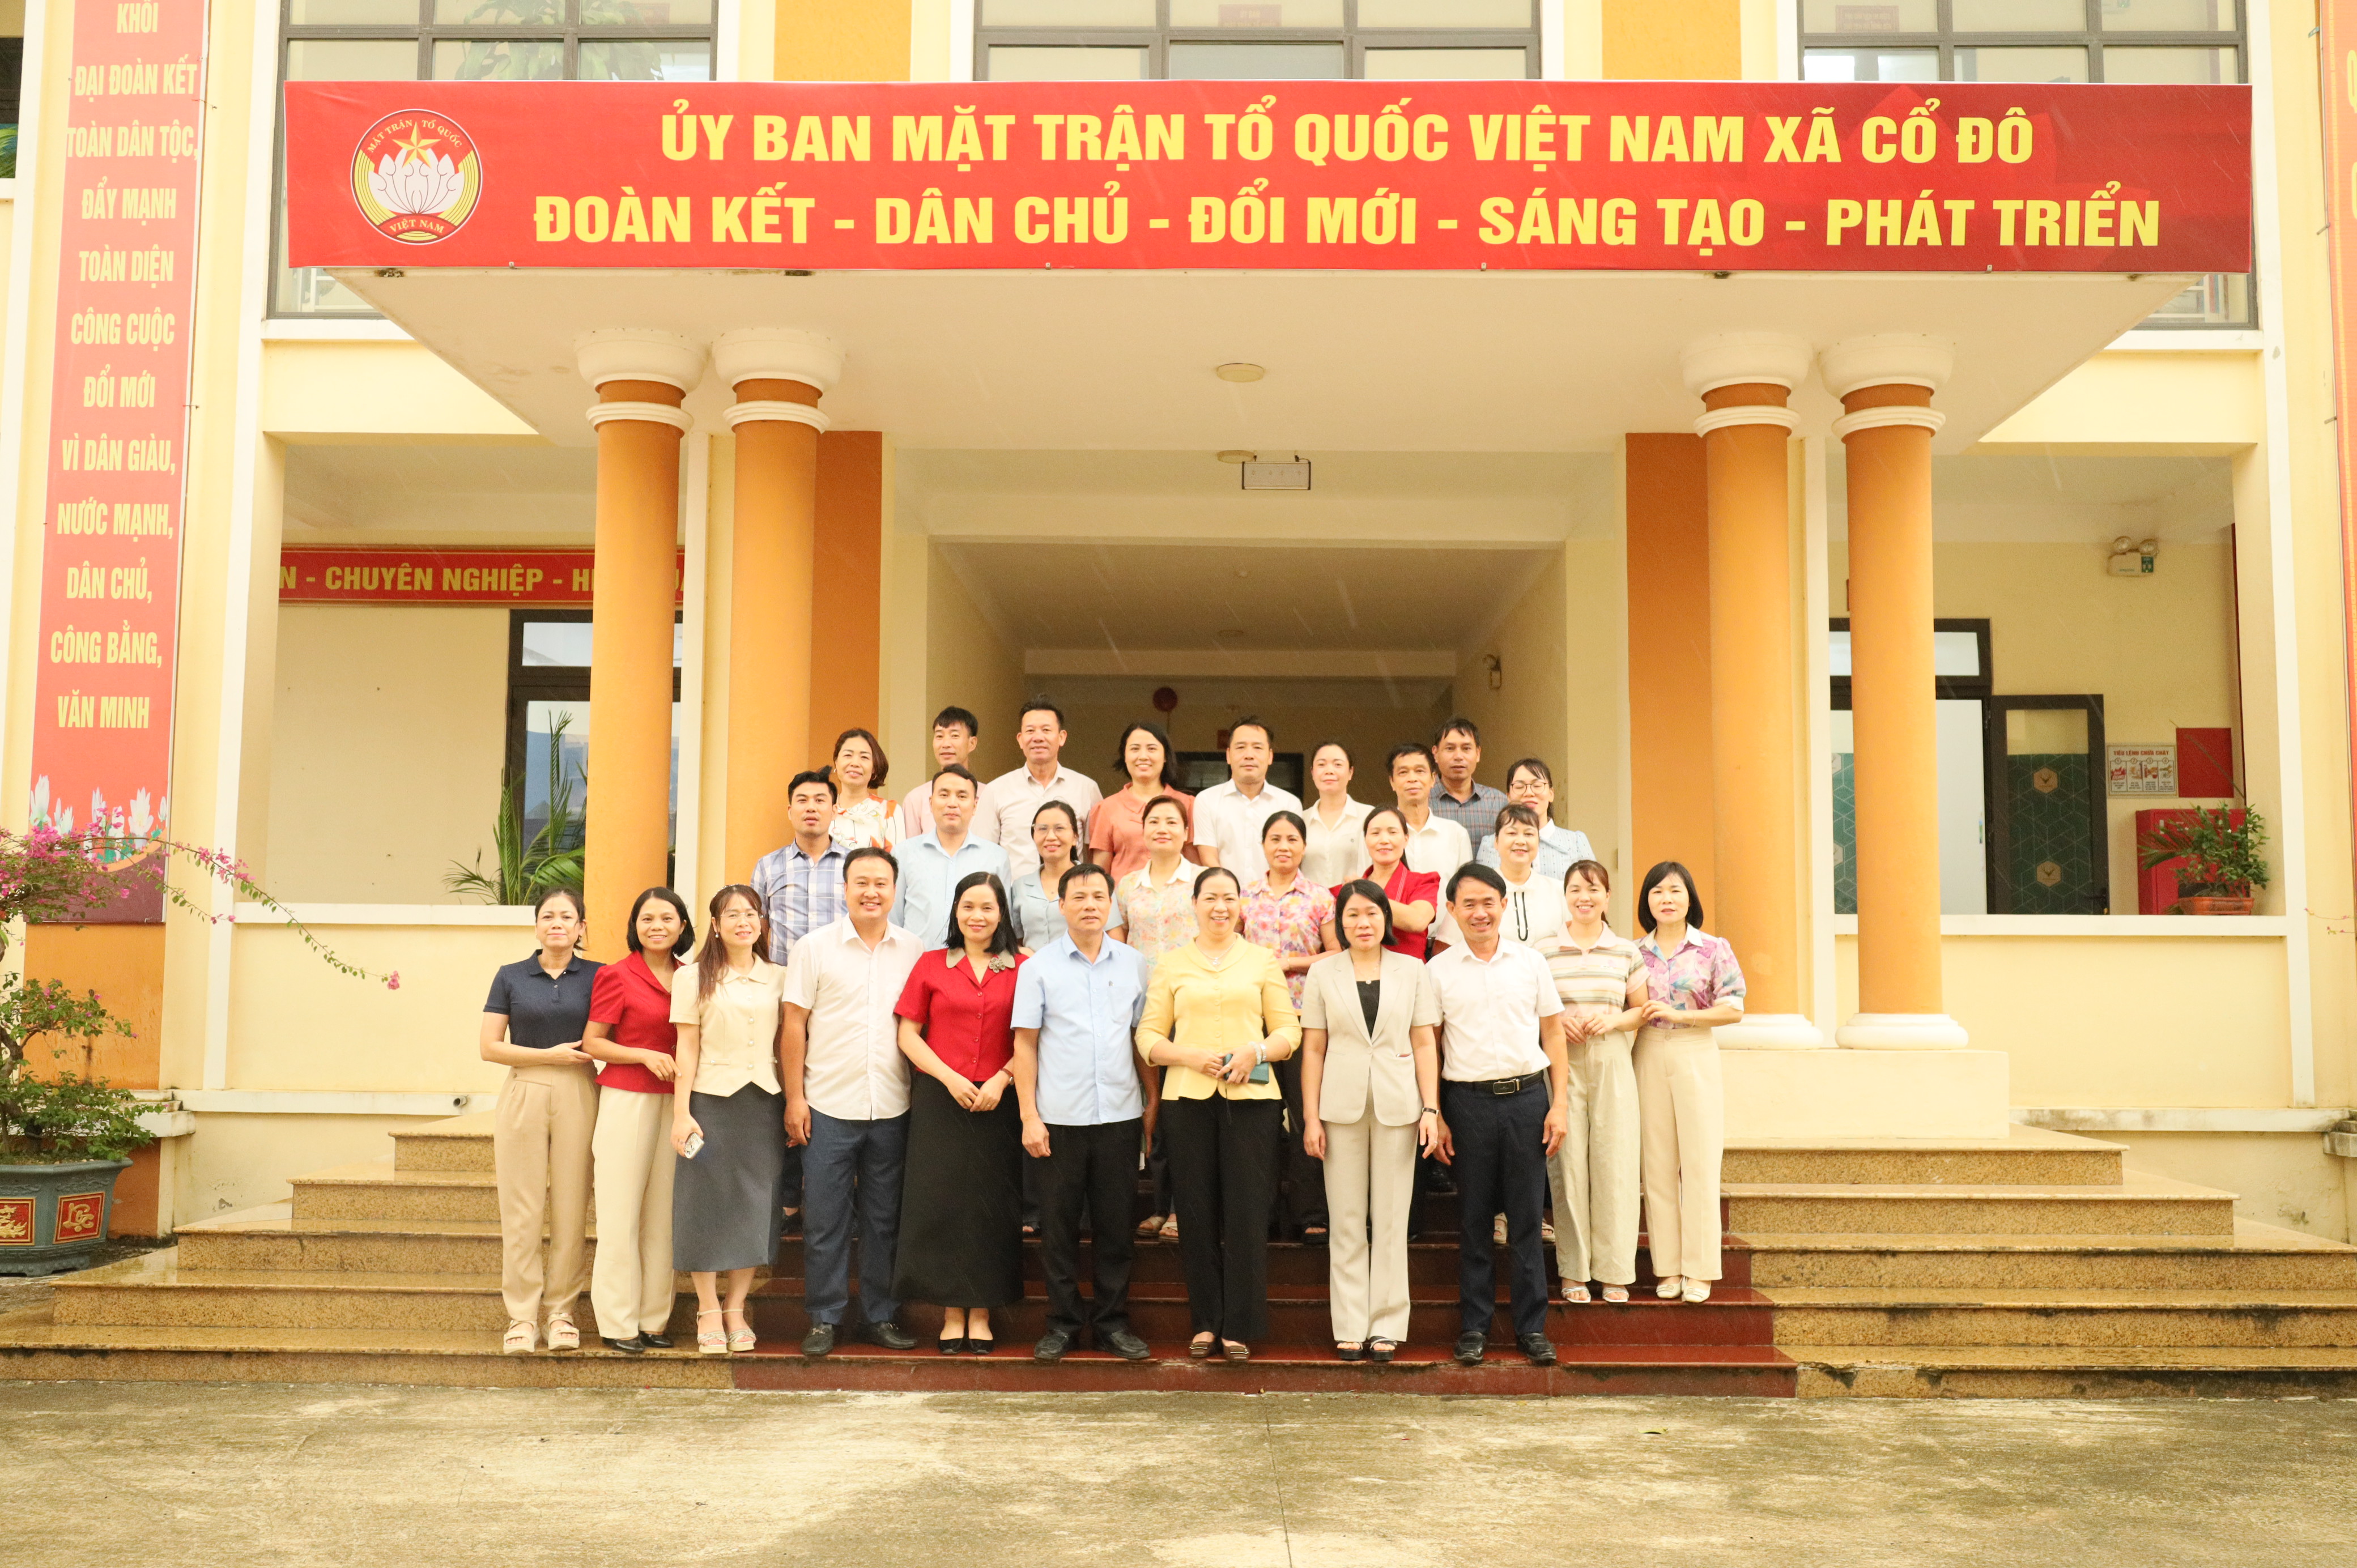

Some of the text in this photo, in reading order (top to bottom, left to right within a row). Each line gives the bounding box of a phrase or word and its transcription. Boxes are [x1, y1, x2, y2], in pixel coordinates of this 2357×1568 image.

[75, 54, 197, 101] ĐẠI ĐOÀN KẾT
[66, 120, 198, 163] TOÀN DÂN TỘC,
[367, 132, 385, 153] MẶT
[385, 120, 413, 134] TRẬN
[437, 126, 462, 148] QUỐC
[662, 95, 2033, 171] ỦY BAN MẶT TRẬN TỔ QUỐC VIỆT NAM XÃ CỔ ĐÔ
[82, 176, 176, 225] ĐẨY MẠNH
[534, 178, 2160, 255] ĐOÀN KẾT - DÂN CHỦ - ĐỔI MỚI - SÁNG TẠO - PHÁT TRIỂN
[389, 219, 445, 233] VIỆT NAM
[79, 244, 174, 288] TOÀN DIỆN
[71, 307, 175, 351] CÔNG CUỘC
[83, 364, 155, 407] ĐỔI MỚI
[62, 433, 175, 474] VÌ DÂN GIÀU,
[57, 497, 173, 542] NƯỚC MẠNH,
[66, 557, 152, 602] DÂN CHỦ,
[326, 563, 433, 590] CHUYÊN
[443, 564, 543, 596] NGHIỆP
[51, 620, 162, 667] CÔNG BẰNG,
[58, 691, 149, 728] VĂN MINH
